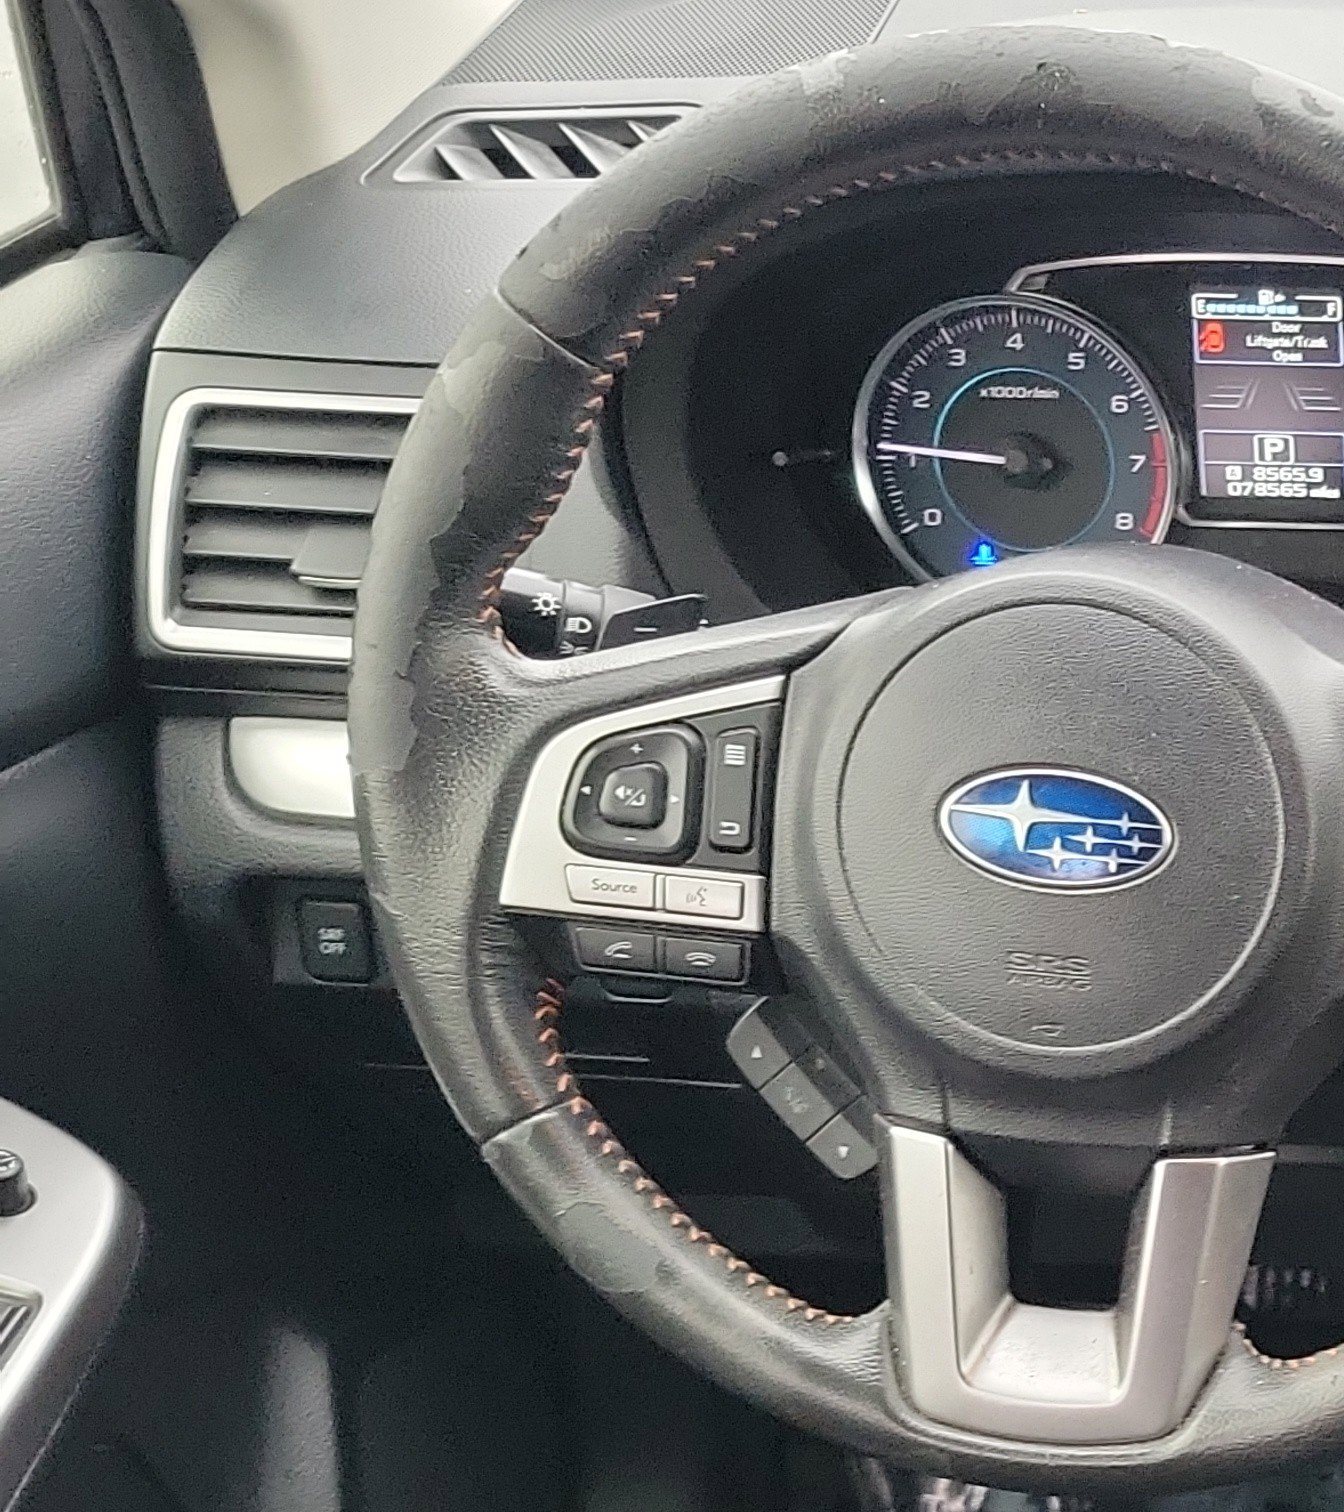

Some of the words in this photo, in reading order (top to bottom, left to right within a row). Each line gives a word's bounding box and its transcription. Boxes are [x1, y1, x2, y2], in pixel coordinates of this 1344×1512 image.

[1271, 322, 1302, 334] Door
[1004, 332, 1024, 351] 4
[949, 349, 966, 367] 3
[1067, 352, 1085, 370] 5
[1272, 351, 1303, 363] Open
[912, 390, 931, 409] 2
[1110, 395, 1129, 413] 6
[1263, 438, 1285, 462] P
[1129, 455, 1147, 473] 7
[1252, 467, 1324, 482] 8565.9
[1227, 483, 1308, 497] 078565
[923, 508, 942, 526] 0
[1115, 512, 1134, 531] 8
[591, 878, 638, 894] Source
